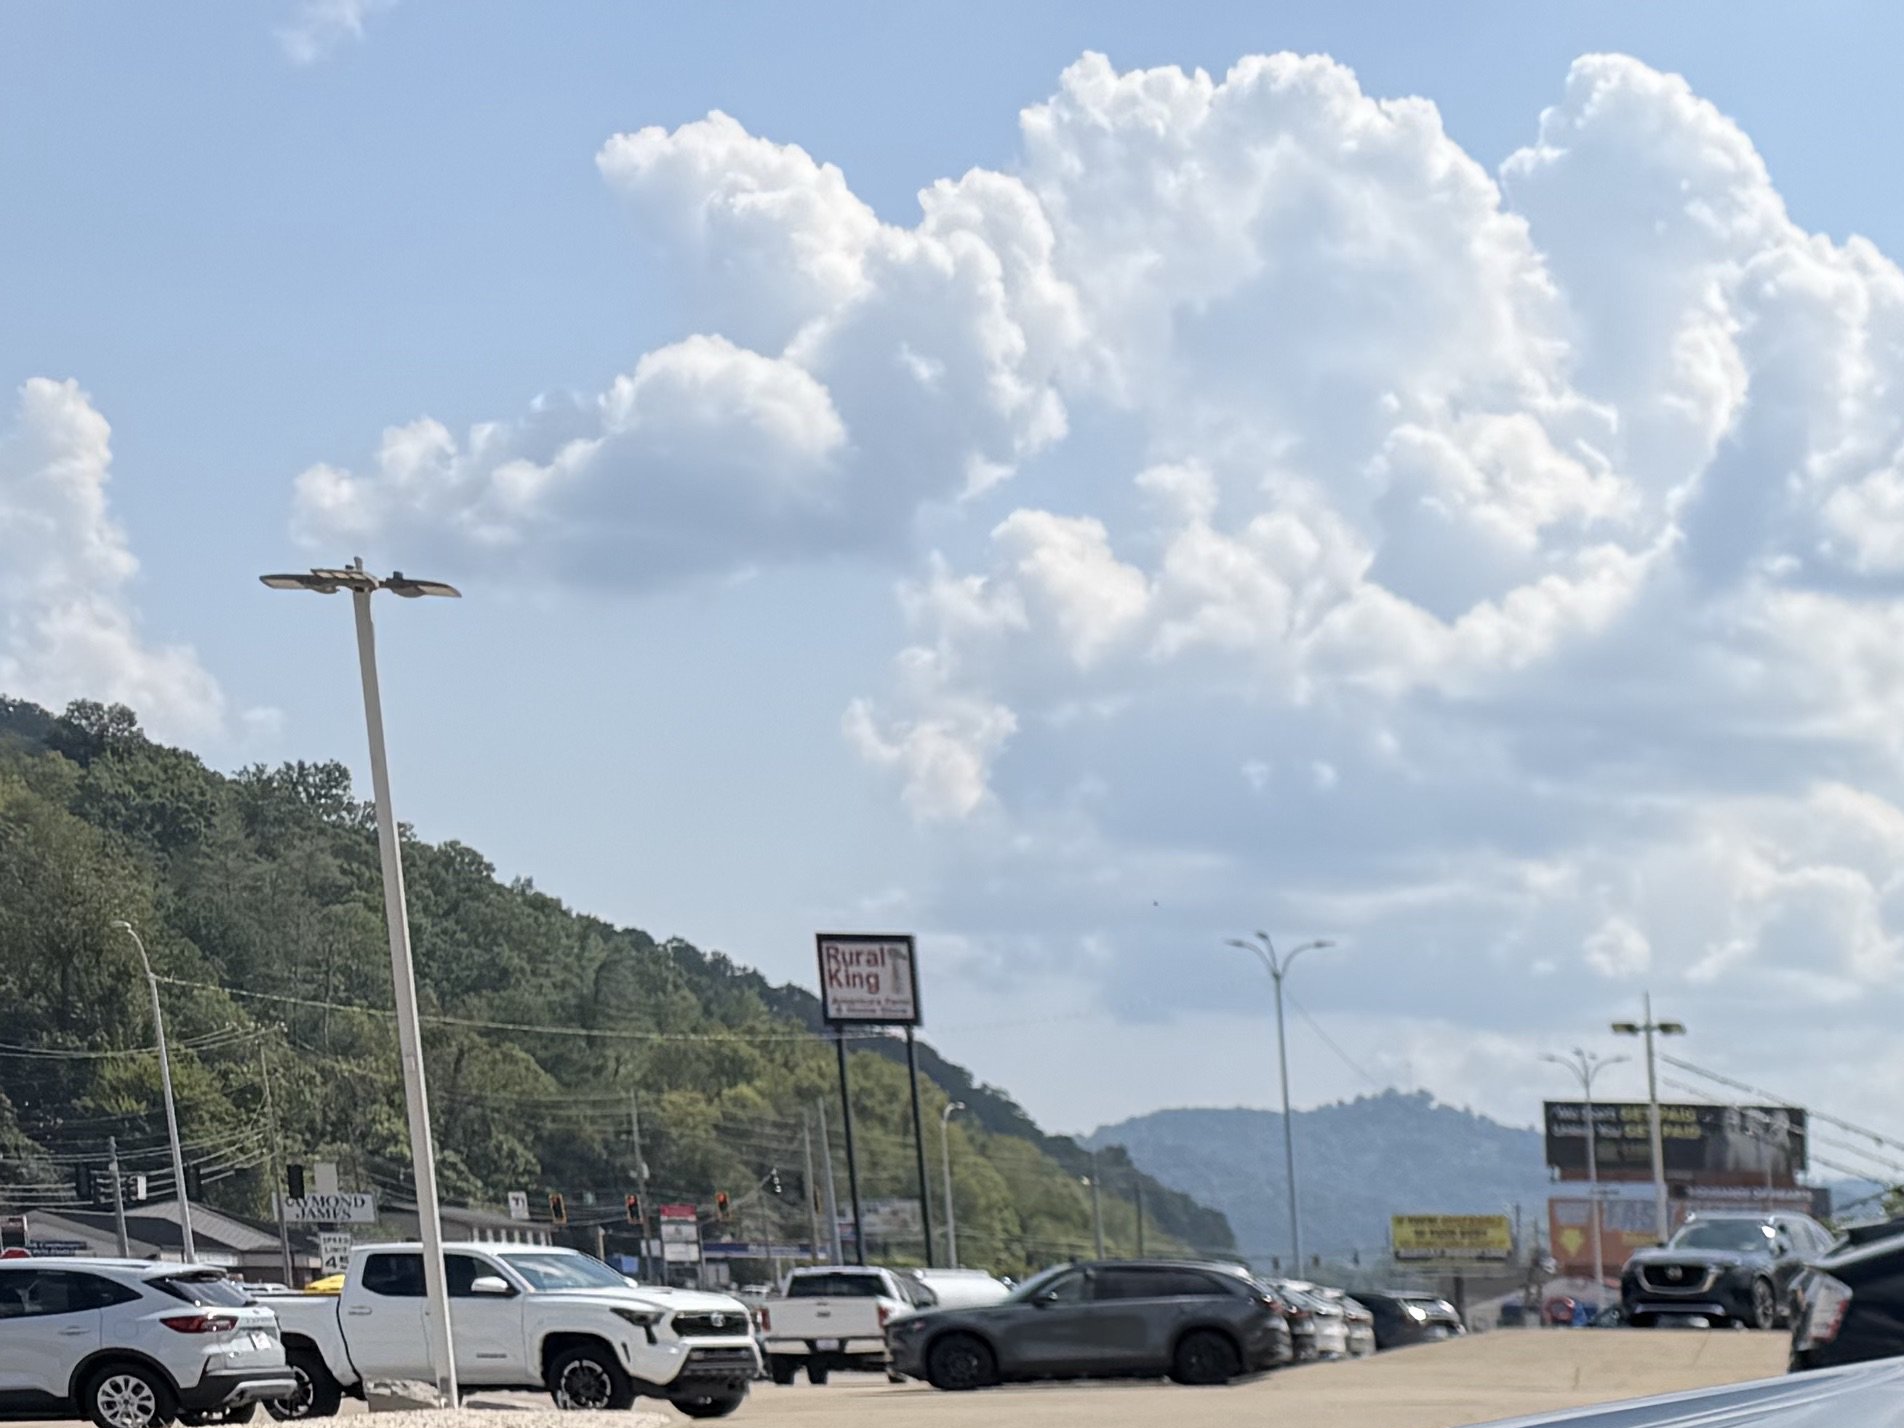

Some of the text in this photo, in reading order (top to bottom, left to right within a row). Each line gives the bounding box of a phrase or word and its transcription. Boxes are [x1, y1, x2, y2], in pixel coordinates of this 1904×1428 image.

[826, 946, 885, 967] Rural
[828, 966, 880, 995] King
[296, 1207, 351, 1219] JAMES
